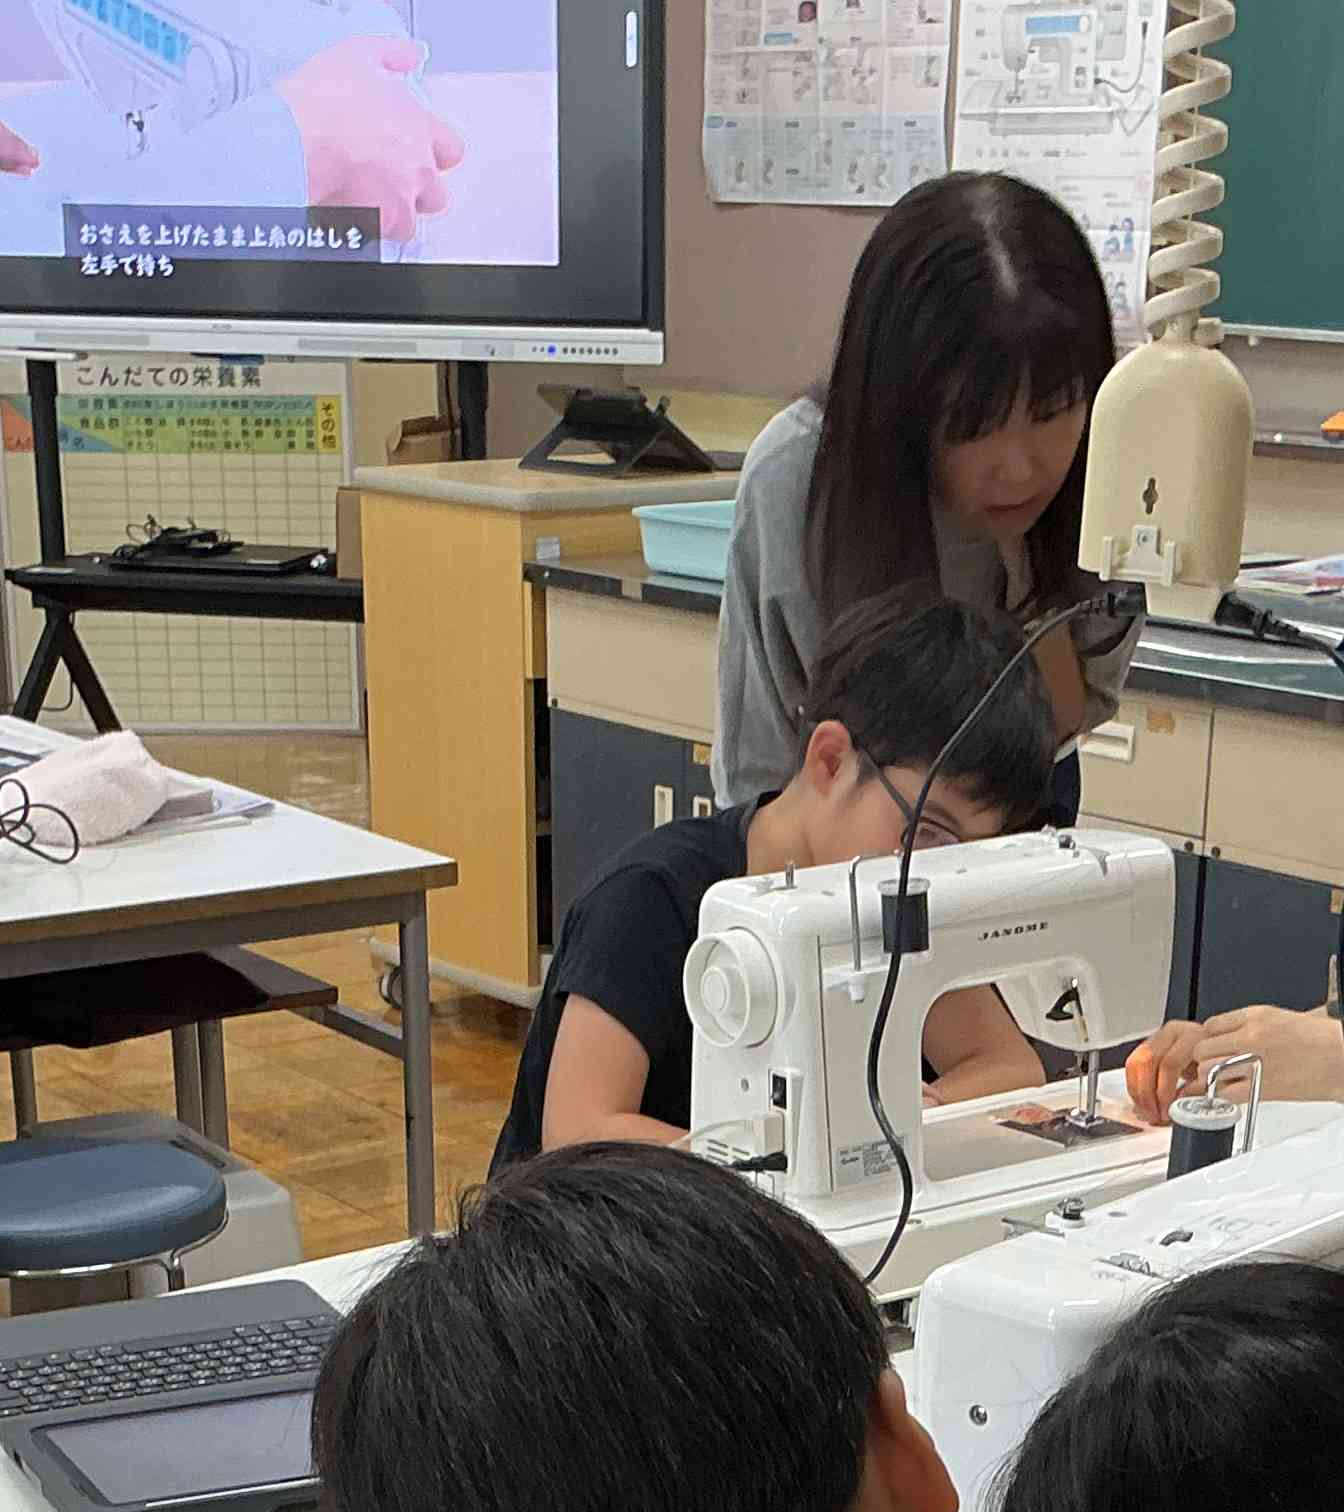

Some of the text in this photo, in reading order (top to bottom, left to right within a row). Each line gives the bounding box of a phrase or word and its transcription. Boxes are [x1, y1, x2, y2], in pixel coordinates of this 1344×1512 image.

[79, 223, 364, 249] おさえを上げたまま上糸のはしを
[79, 253, 175, 277] 左手で持ち
[76, 364, 262, 389] こんだての栄養素
[320, 401, 337, 449] その他
[977, 921, 1049, 941] JANOME
